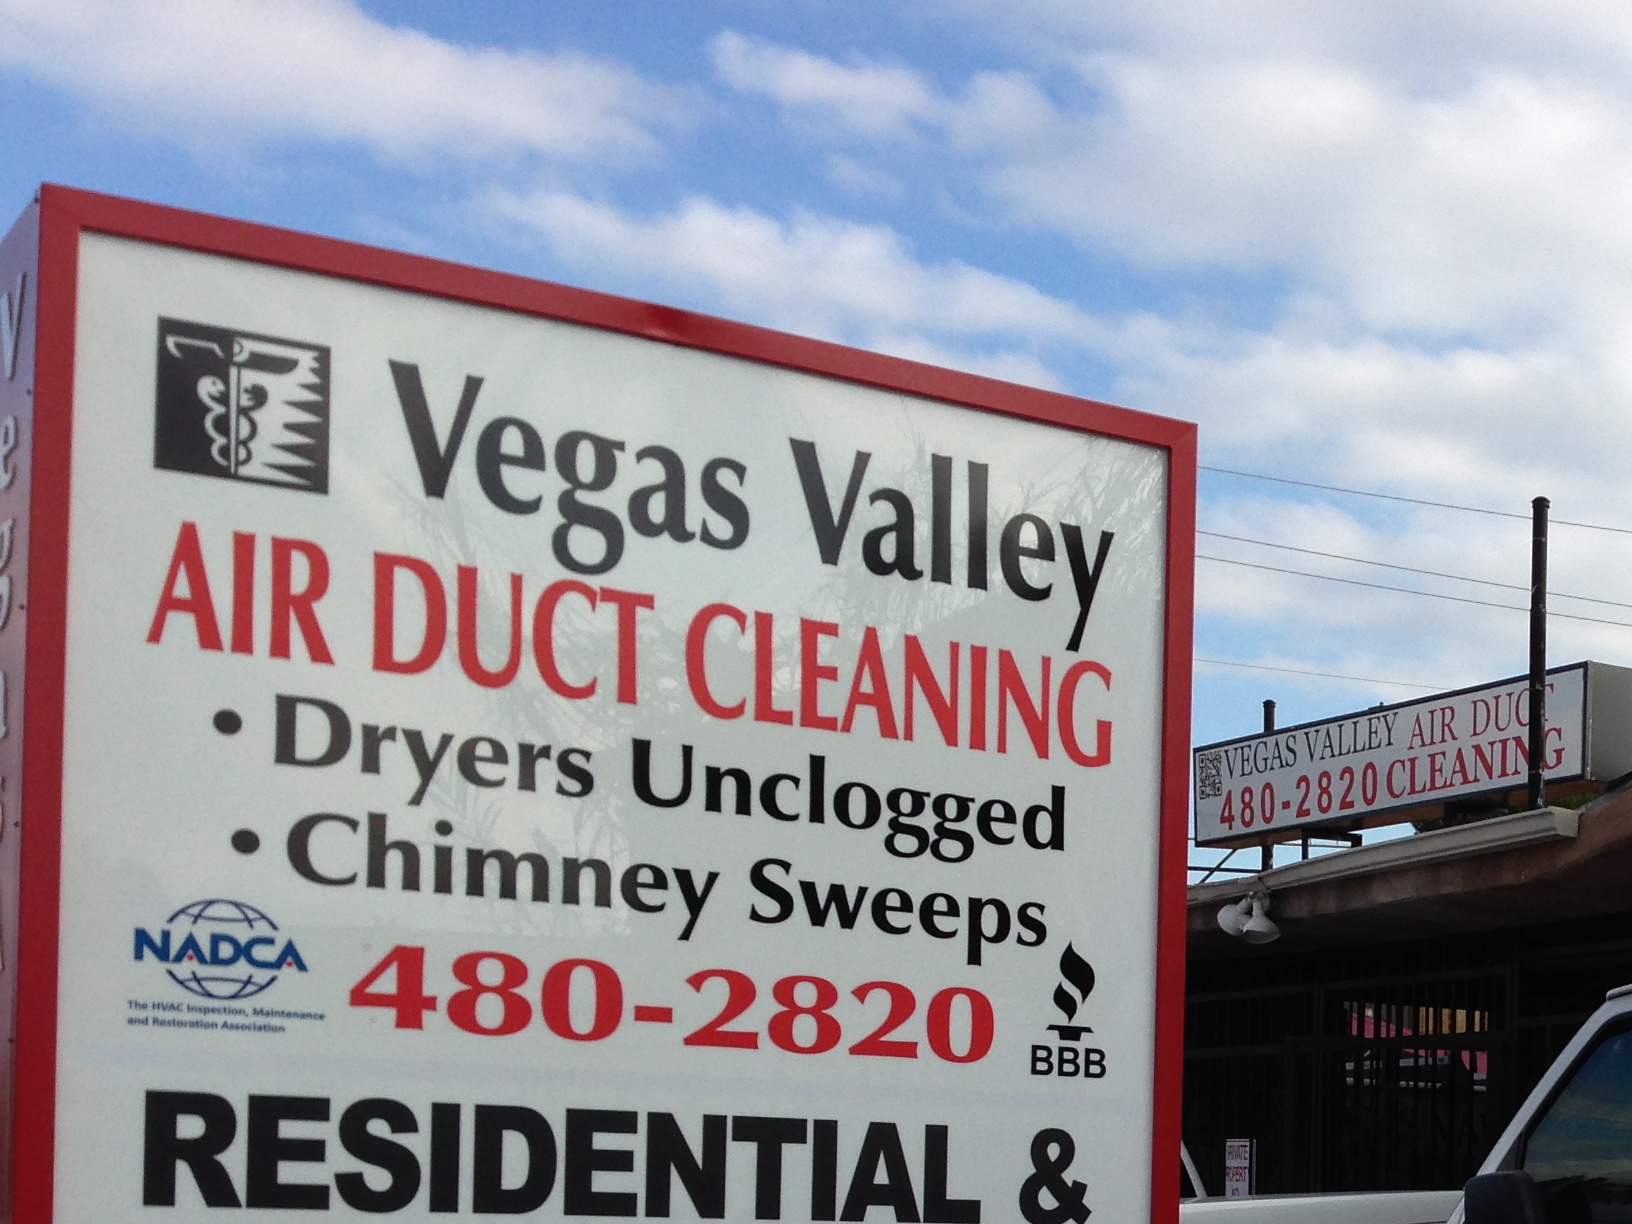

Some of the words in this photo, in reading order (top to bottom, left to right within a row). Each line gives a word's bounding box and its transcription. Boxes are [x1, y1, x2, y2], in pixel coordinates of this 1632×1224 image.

[388, 358, 750, 575] Vegas
[788, 437, 1114, 652] Valley
[146, 521, 335, 666] AIR
[372, 551, 655, 706] DUCT
[685, 602, 1113, 768] CLEANING
[274, 693, 594, 806] Dryers
[631, 737, 1066, 863] Unclogged
[1223, 734, 1298, 780] VEGAS
[1303, 711, 1399, 762] VALLEY
[1407, 706, 1458, 751] AIR
[1220, 761, 1378, 831] 480-2820
[287, 812, 720, 941] Chimney
[749, 857, 1048, 967] Sweeps
[133, 926, 309, 973] NADCA
[127, 1000, 148, 1010] The
[152, 1001, 183, 1012] HVAC
[187, 1003, 249, 1018] Inspection,
[253, 1007, 326, 1021] Maintenance
[127, 1015, 149, 1026] and
[152, 1016, 219, 1030] Restoration
[221, 1019, 286, 1033] Association
[349, 943, 995, 1064] 480-2820
[1031, 1044, 1107, 1079] BBB
[142, 1088, 981, 1224] RESIDENTIAL
